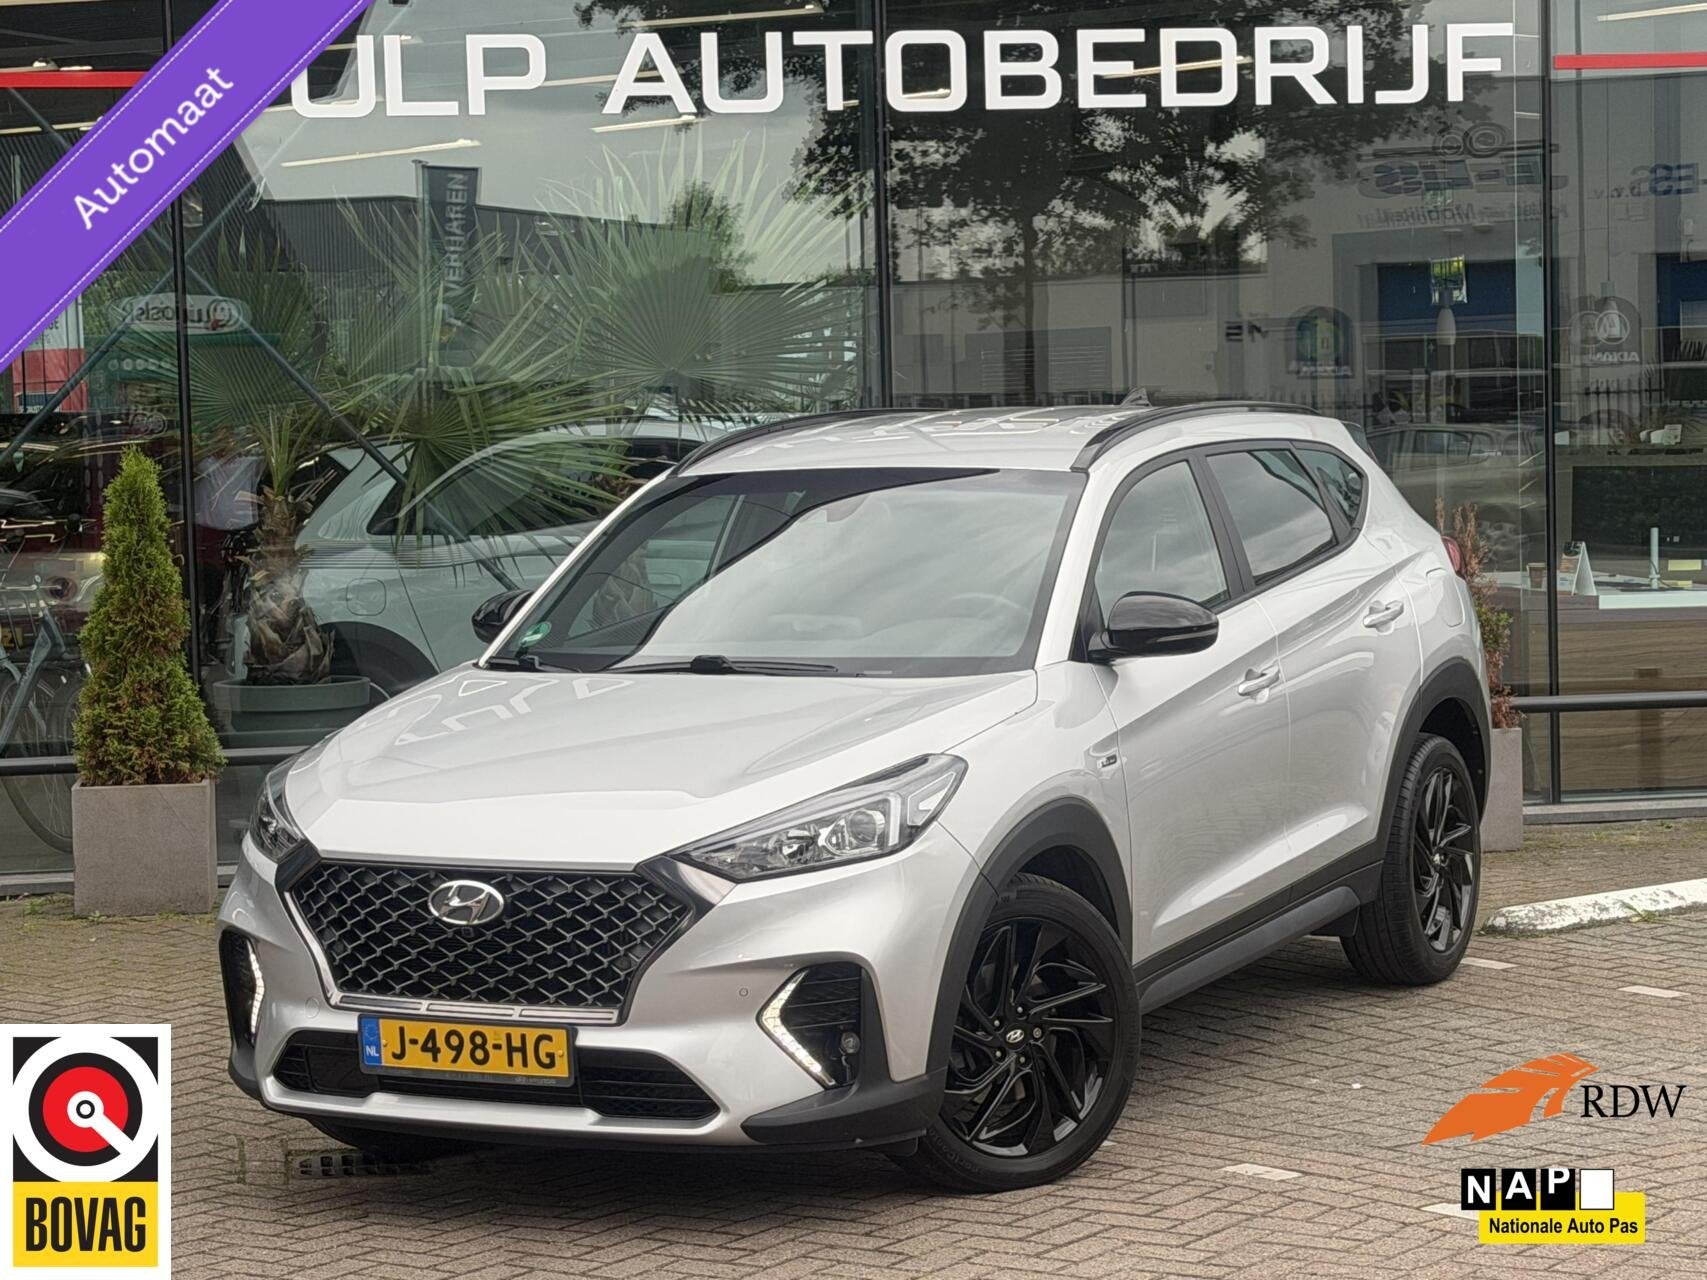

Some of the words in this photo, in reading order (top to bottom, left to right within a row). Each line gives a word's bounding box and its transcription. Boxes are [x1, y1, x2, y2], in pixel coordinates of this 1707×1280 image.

[602, 22, 1515, 115] AUTOBEDRIJF
[366, 1046, 379, 1057] NL
[391, 1026, 556, 1070] J-498-HG
